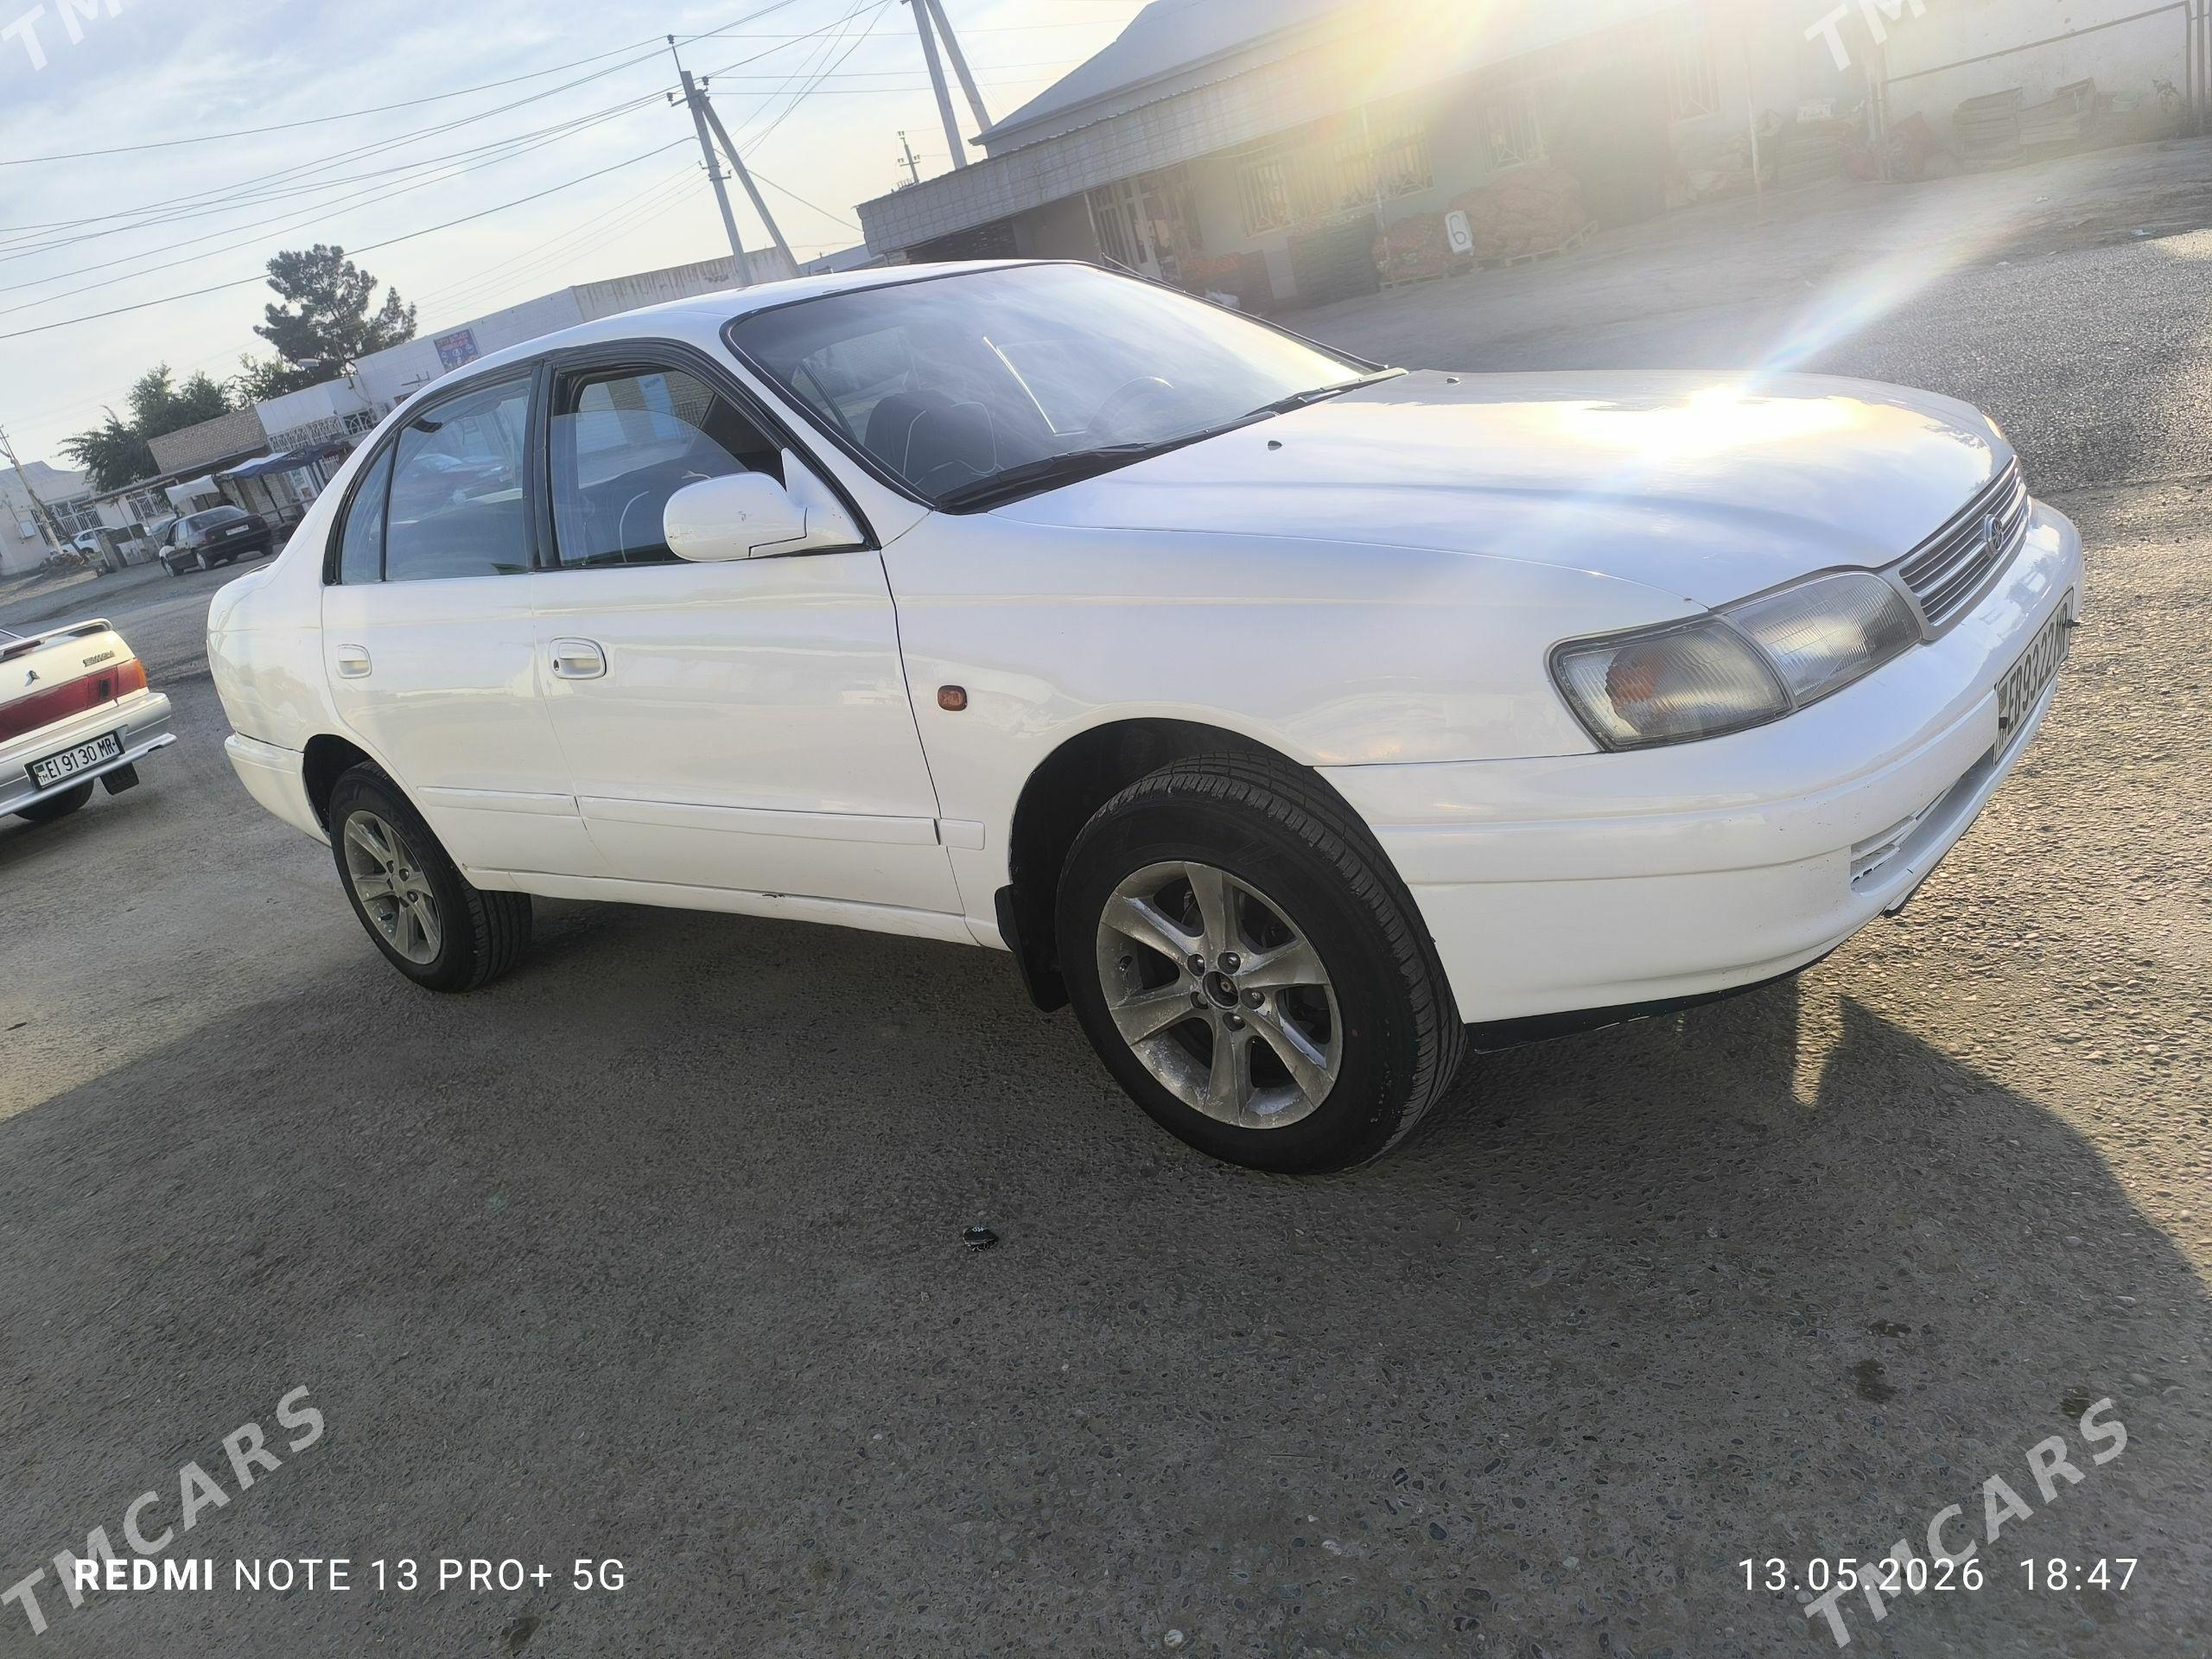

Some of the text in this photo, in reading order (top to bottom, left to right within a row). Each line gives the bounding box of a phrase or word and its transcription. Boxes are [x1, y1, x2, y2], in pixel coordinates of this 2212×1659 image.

[1449, 215, 1466, 245] 6
[2023, 621, 2054, 712] 9322
[61, 745, 97, 772] 9130
[97, 738, 115, 758] MR
